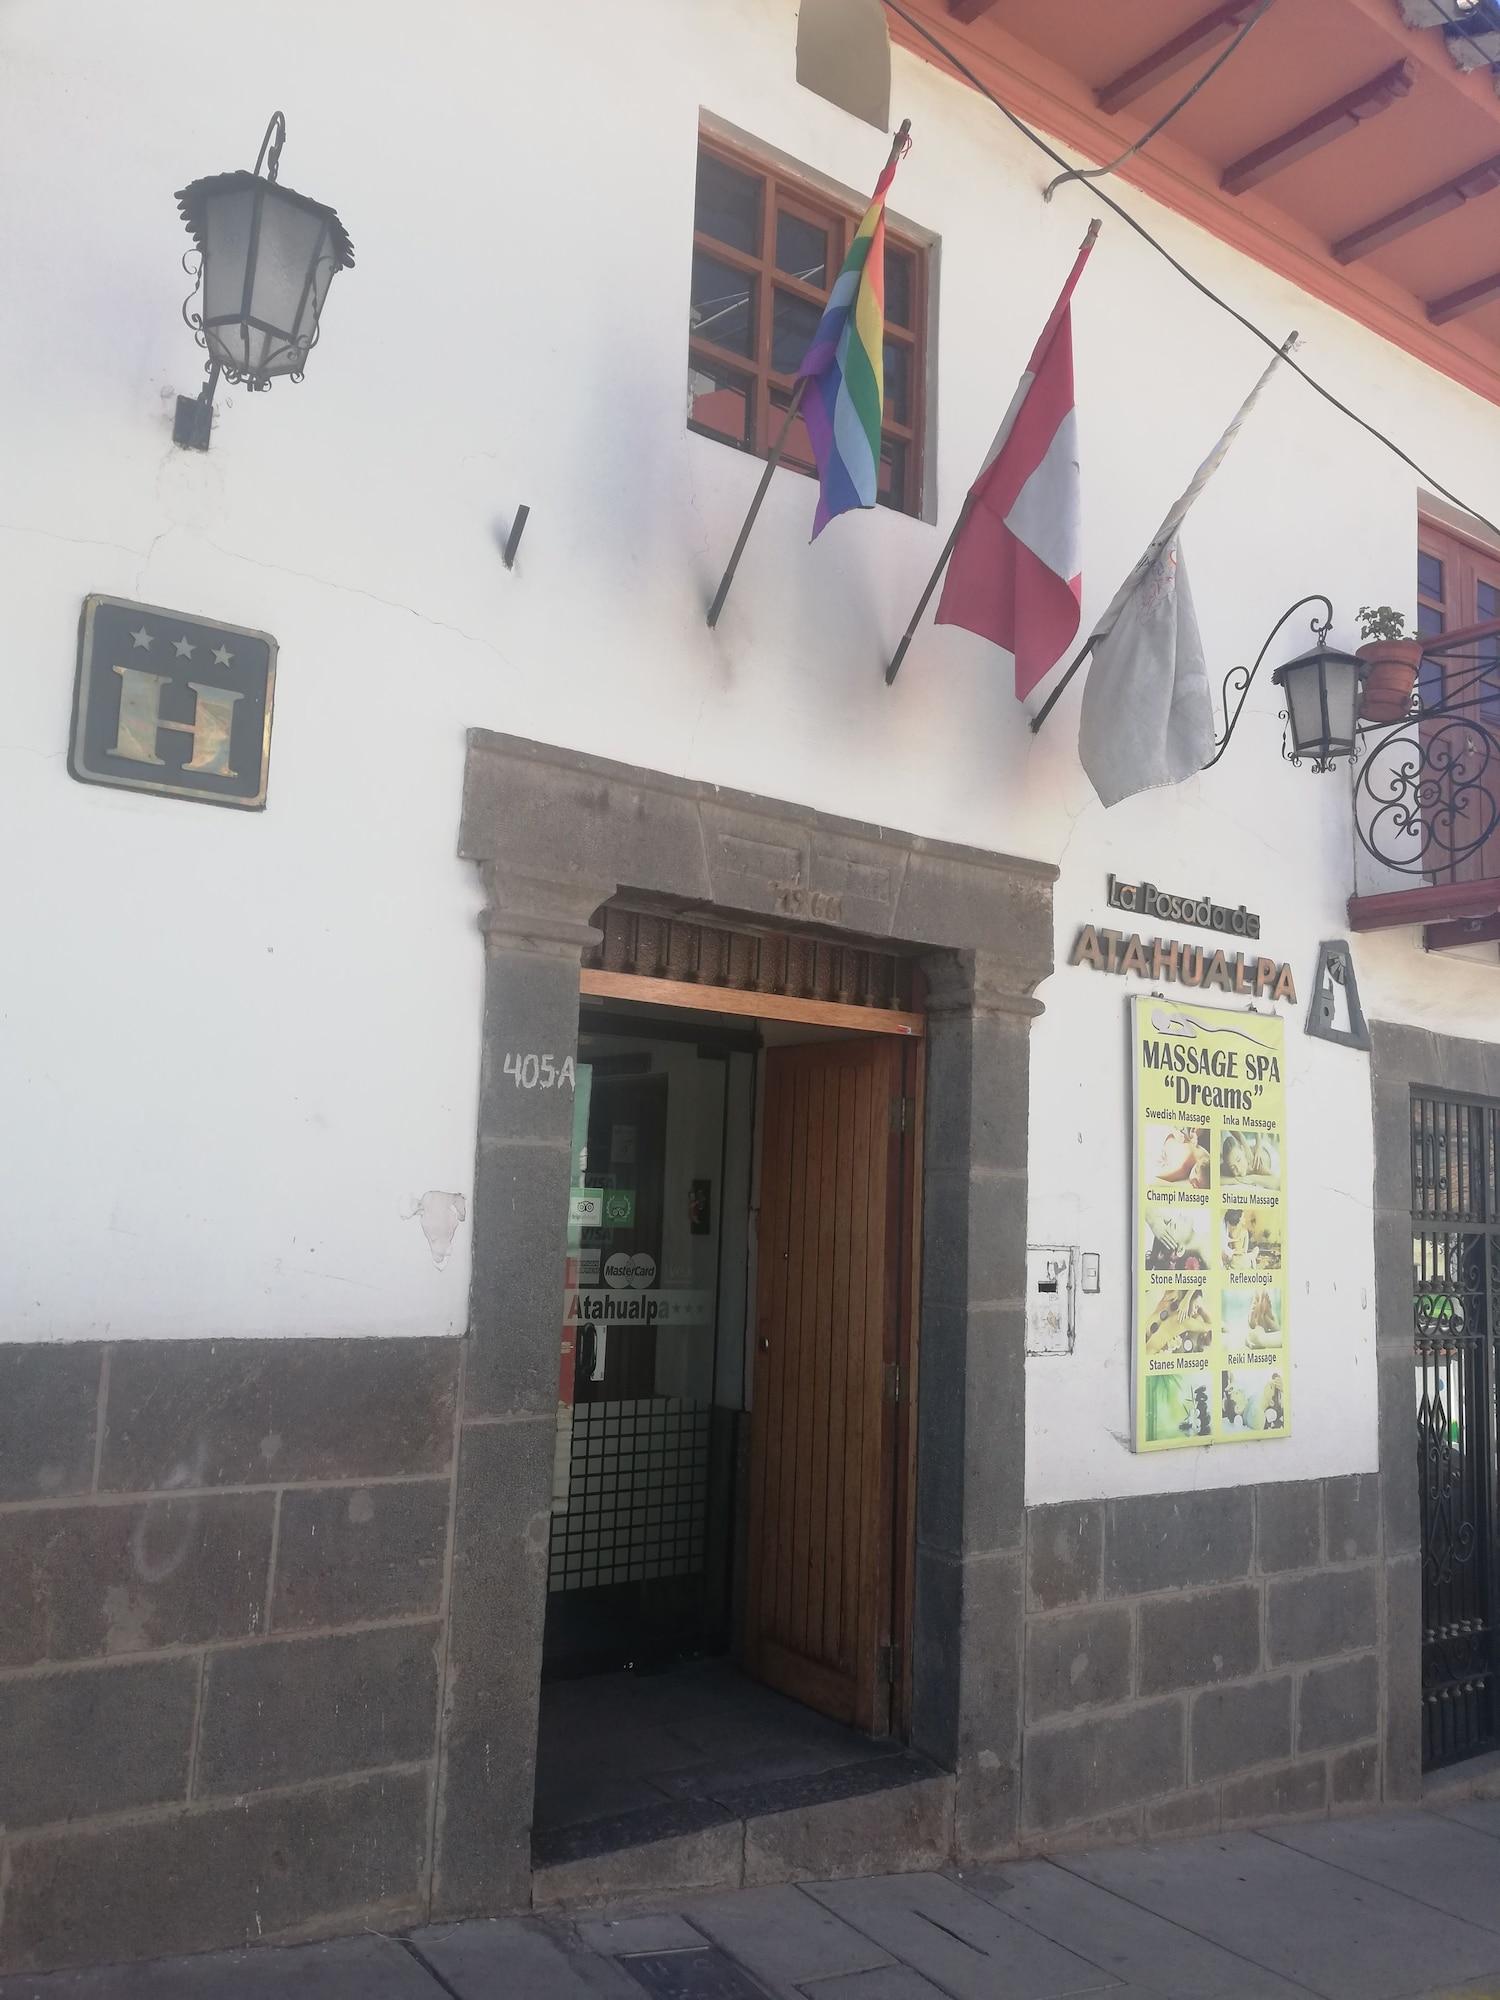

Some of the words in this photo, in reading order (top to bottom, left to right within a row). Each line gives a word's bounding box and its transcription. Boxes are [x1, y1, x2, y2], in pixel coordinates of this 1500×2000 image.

[106, 664, 245, 778] H
[1107, 873, 1137, 909] La
[1143, 881, 1227, 931] Posada
[1231, 905, 1260, 938] de
[1071, 924, 1298, 1004] ATAHUALPA
[1142, 1040, 1239, 1079] MASSAGE
[1245, 1053, 1281, 1083] SPA
[1145, 1107, 1177, 1120] Swedish
[1178, 1110, 1211, 1125] Massage
[1223, 1114, 1240, 1126] Inka
[1242, 1116, 1277, 1130] Massage
[1146, 1190, 1176, 1204] Champi
[1178, 1191, 1210, 1205] Massage
[1222, 1193, 1248, 1204] Shiatzu
[1249, 1194, 1279, 1207] Massage
[605, 1264, 655, 1278] MasterCard
[1150, 1273, 1173, 1285] Stone
[1175, 1273, 1207, 1286] Massage
[567, 1294, 670, 1324] Atahualpa
[1149, 1359, 1175, 1371] Stanes
[1176, 1358, 1209, 1370] Massage
[1227, 1354, 1246, 1365] Reiki
[1247, 1353, 1277, 1365] Massage
